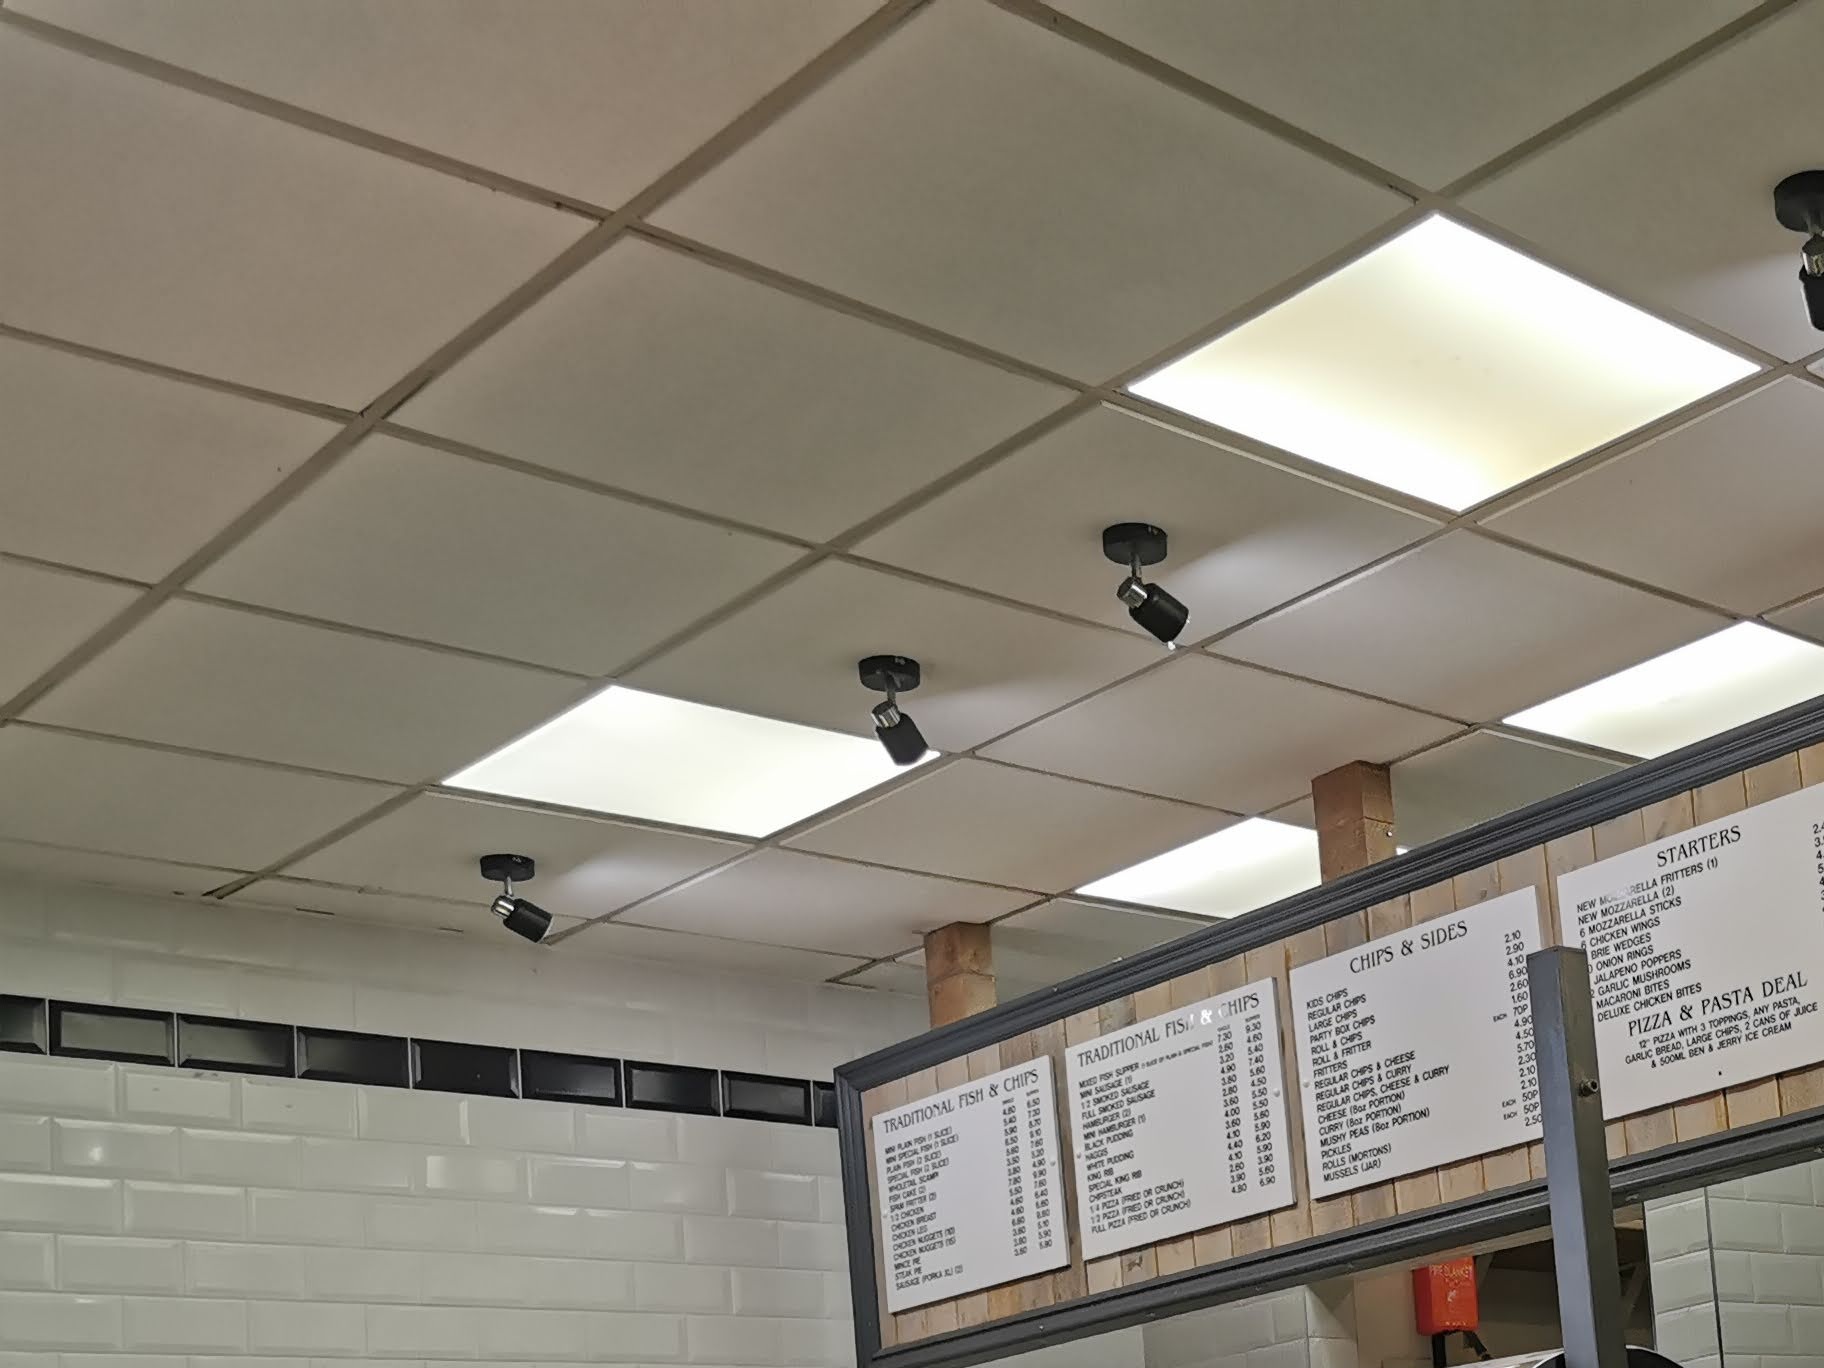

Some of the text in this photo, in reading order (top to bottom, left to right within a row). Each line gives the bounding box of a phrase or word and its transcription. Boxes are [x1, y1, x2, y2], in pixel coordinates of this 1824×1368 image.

[1656, 825, 1741, 868] STARTERS
[1577, 884, 1675, 926] NEW MOZZARELLA (2)
[1349, 920, 1468, 974] CHIPS & SIDES
[1504, 929, 1522, 944] 2.10
[1589, 916, 1661, 948] CHICKEN WINGS
[1308, 1008, 1358, 1033] LARGE CHIPS
[1628, 971, 1808, 1037] PIZZA & PASTA DEAL
[882, 1099, 955, 1134] TRADITIONAL
[958, 1087, 984, 1109] FISH
[1003, 1068, 1039, 1093] CHIPS
